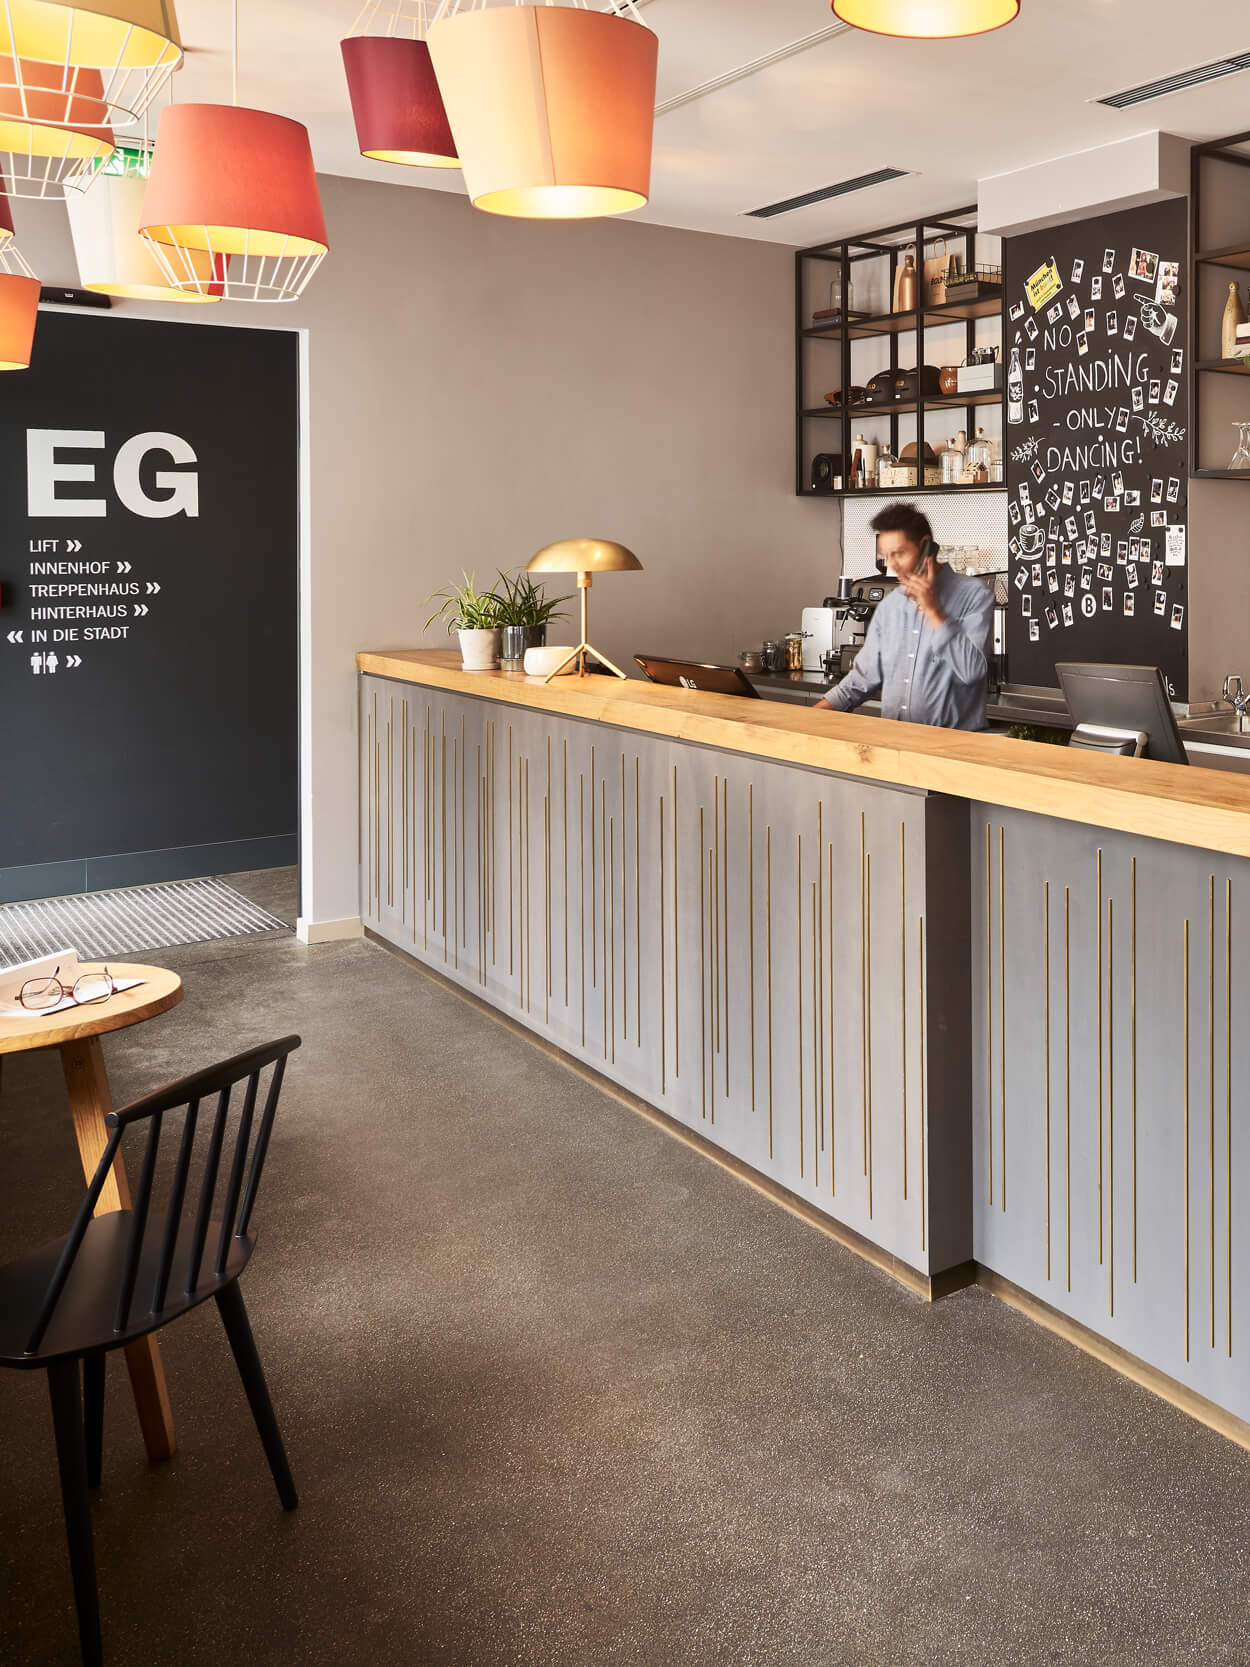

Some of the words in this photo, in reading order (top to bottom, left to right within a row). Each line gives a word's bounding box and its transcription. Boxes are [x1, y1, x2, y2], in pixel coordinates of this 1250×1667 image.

[1031, 268, 1053, 292] München
[1044, 325, 1072, 351] NO
[1043, 349, 1149, 399] STANDING
[1067, 407, 1117, 430] ONLY
[1047, 436, 1143, 472] DANCING!
[27, 429, 199, 518] EG
[30, 540, 59, 552] LIFT
[30, 562, 110, 574] INNENHOF
[29, 583, 139, 597] TREPPENHAUS
[31, 605, 127, 620] HINTERHAUS
[32, 630, 47, 642] IN
[53, 629, 79, 641] DIE
[84, 627, 129, 640] STADT
